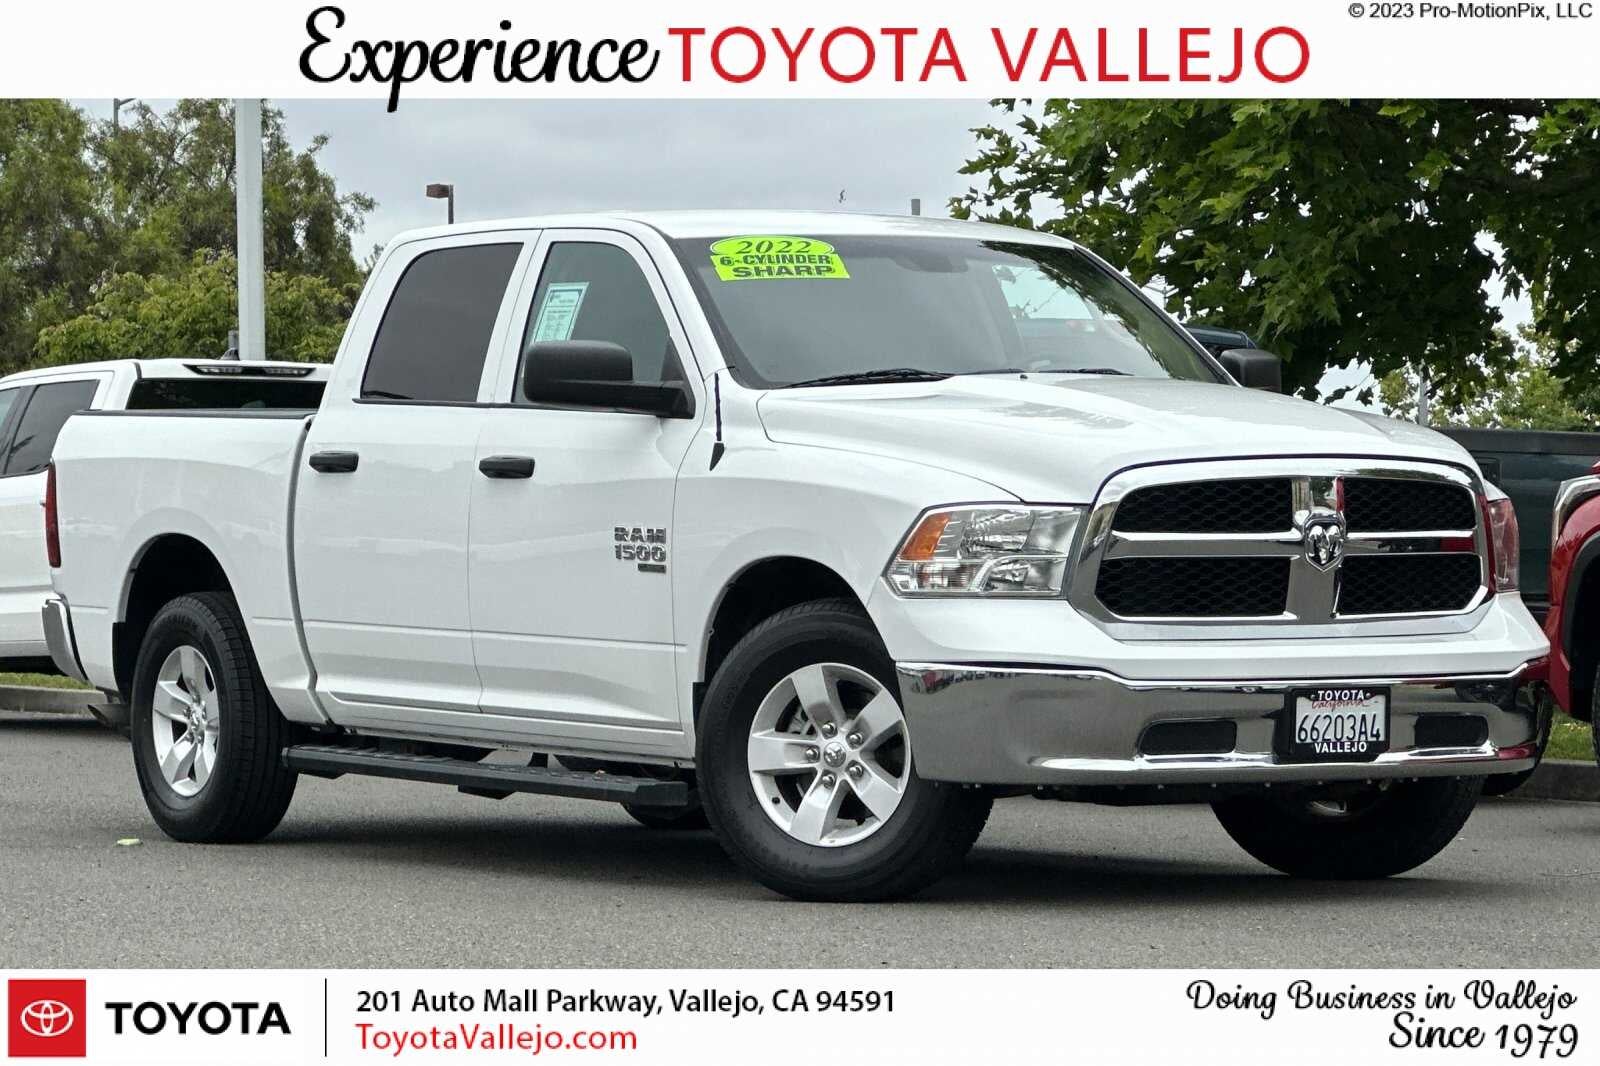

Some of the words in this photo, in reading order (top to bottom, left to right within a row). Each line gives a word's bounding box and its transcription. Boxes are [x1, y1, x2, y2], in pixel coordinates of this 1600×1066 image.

[735, 240, 812, 255] 2022
[719, 254, 833, 266] 6-CYLINDER
[732, 265, 835, 278] SHARP
[614, 526, 667, 544] RAM
[614, 544, 667, 562] 1500
[1317, 690, 1365, 701] TOYOTA
[1297, 713, 1381, 742] 66203A4
[1314, 741, 1368, 753] VALLEJO
